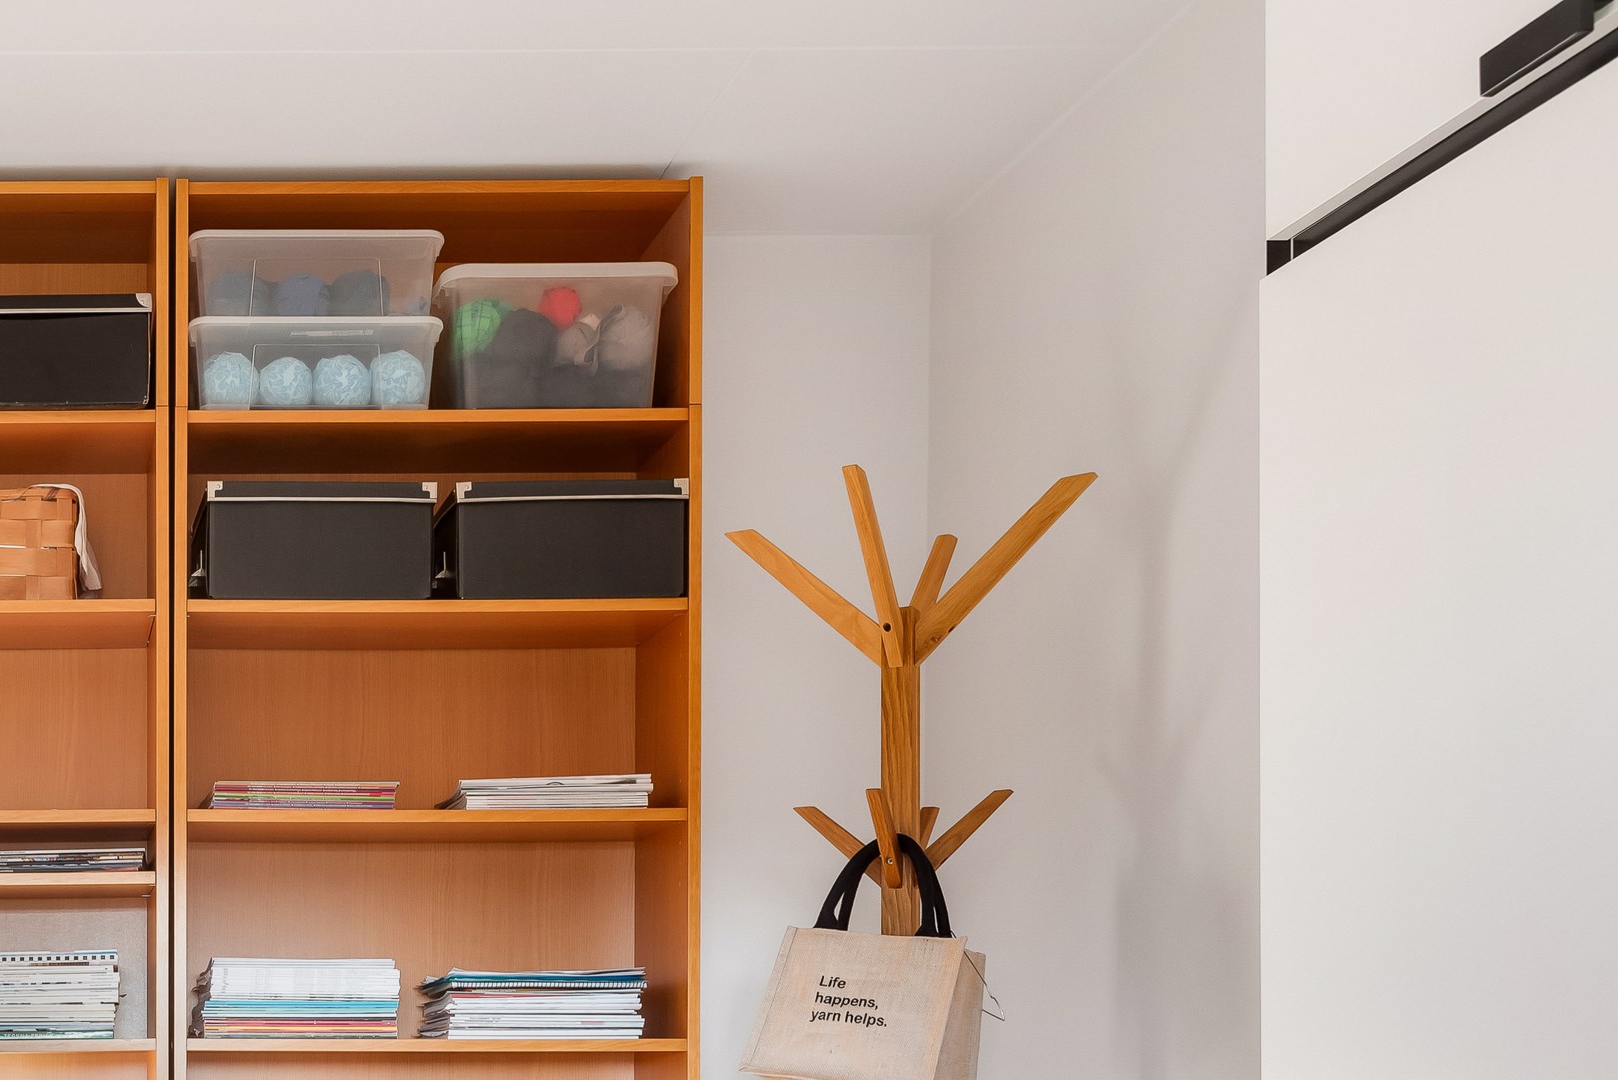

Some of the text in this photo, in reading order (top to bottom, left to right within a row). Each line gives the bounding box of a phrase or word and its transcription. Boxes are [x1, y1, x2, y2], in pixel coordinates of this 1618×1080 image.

[819, 974, 847, 990] Life
[814, 992, 879, 1010] happens,
[809, 1009, 888, 1028] yarn helps.
